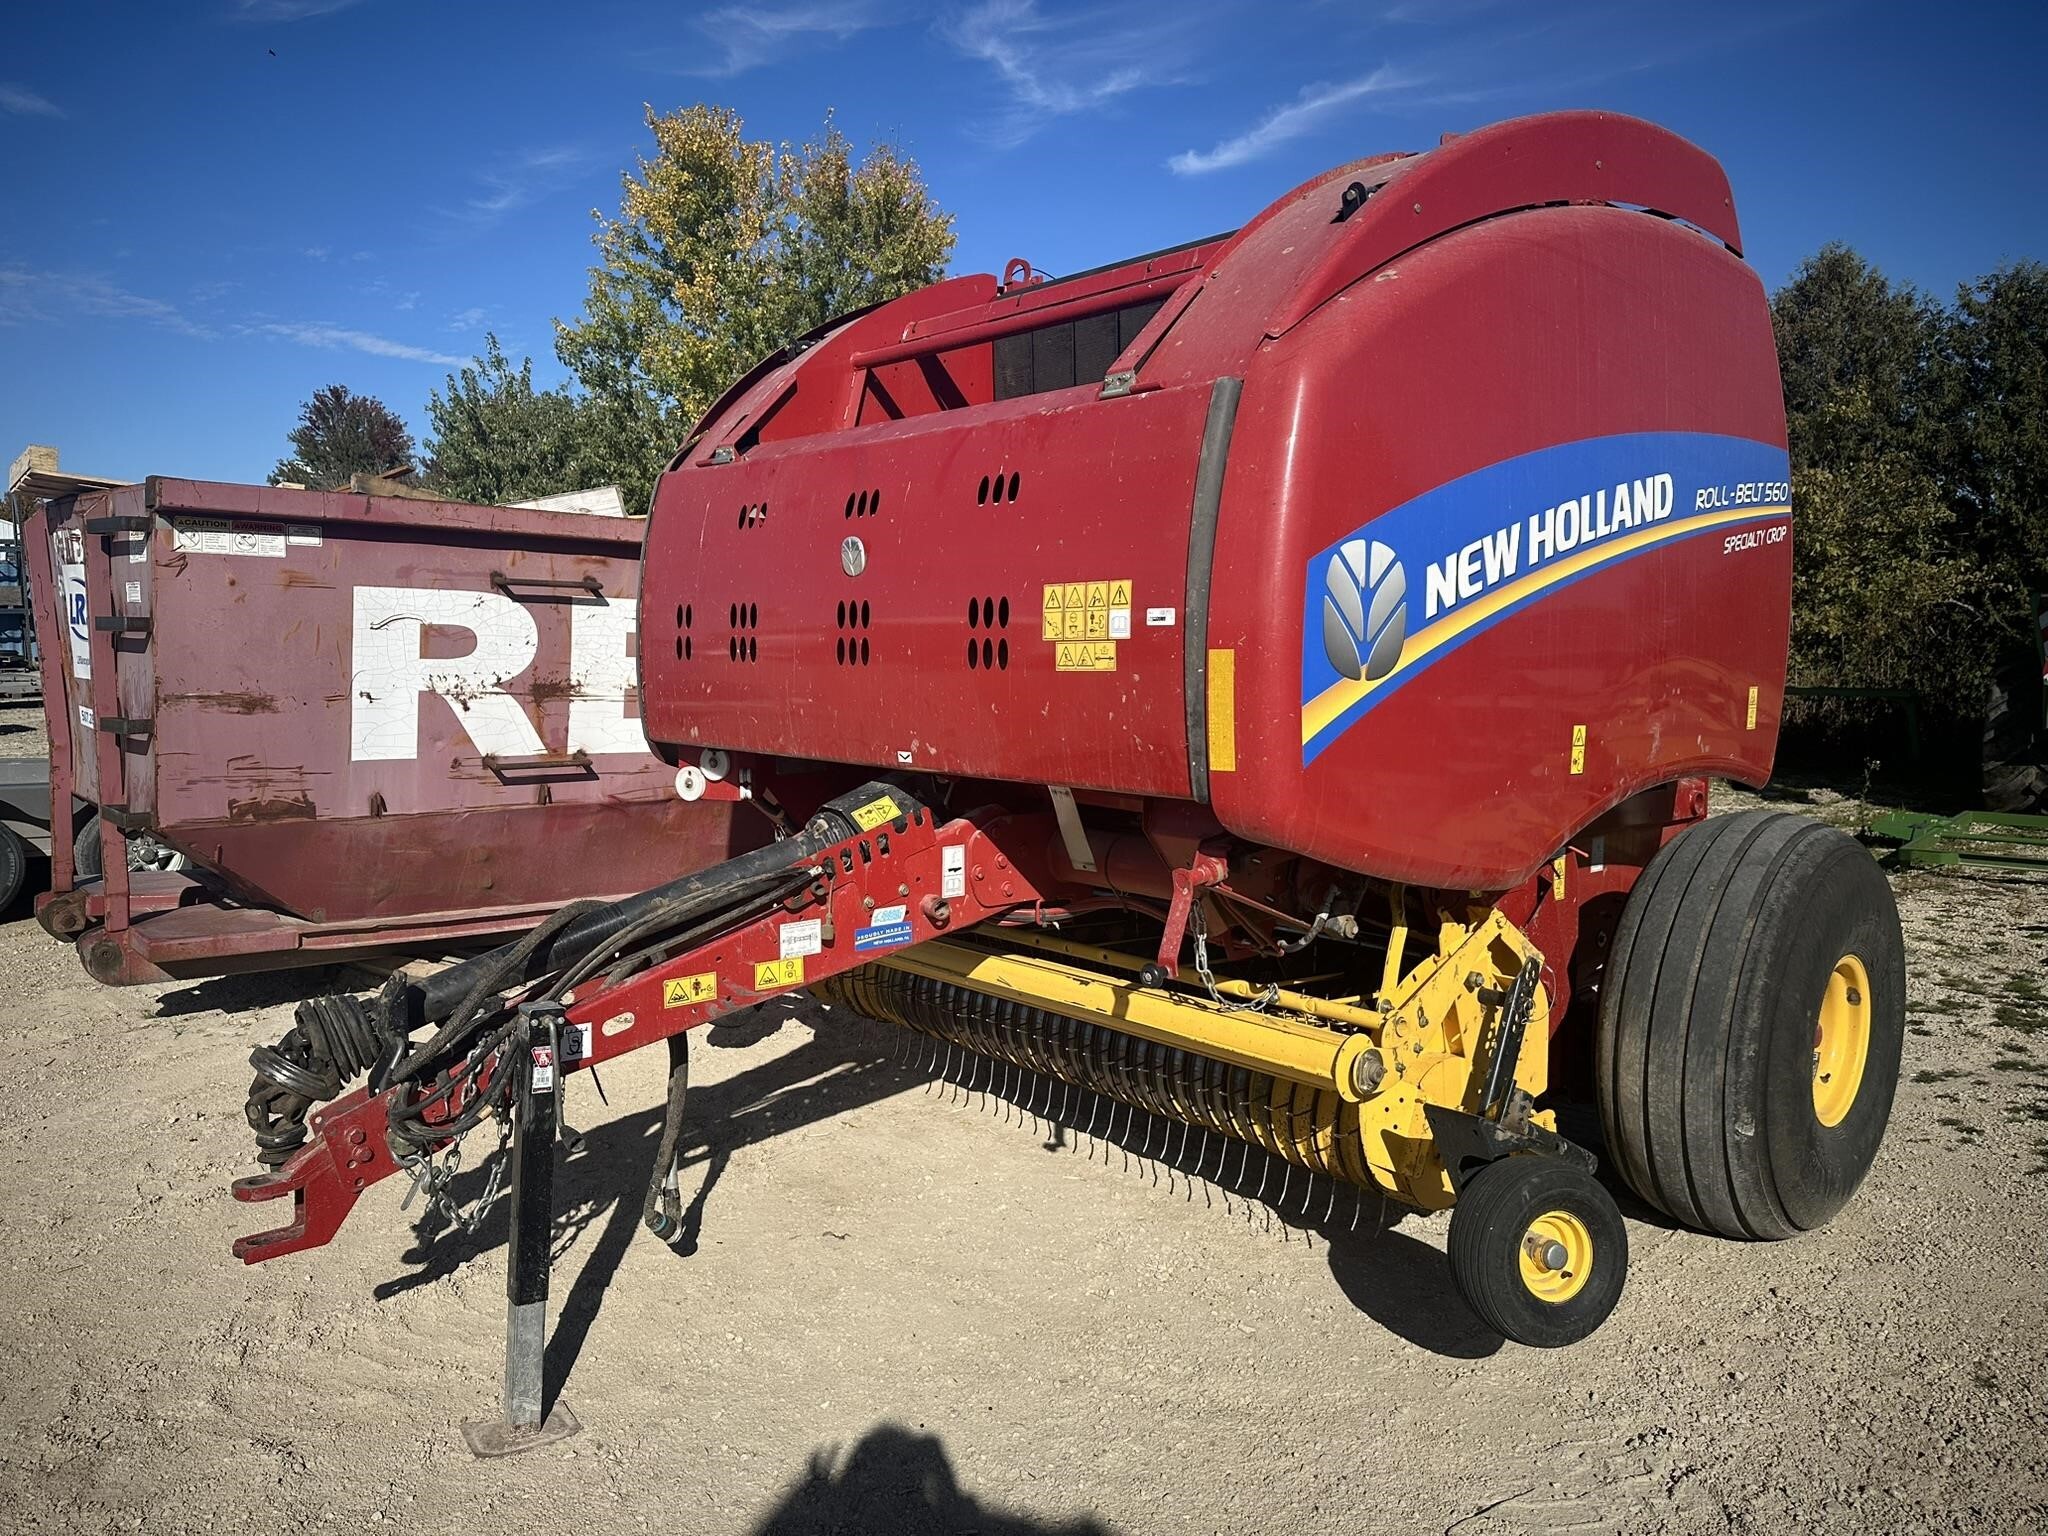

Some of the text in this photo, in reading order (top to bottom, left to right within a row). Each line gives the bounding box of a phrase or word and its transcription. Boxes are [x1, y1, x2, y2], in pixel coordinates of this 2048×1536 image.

[1764, 482, 1788, 502] 560
[184, 518, 227, 528] CAUTION
[239, 523, 282, 532] WARNING
[1425, 472, 1674, 620] NEW HOLLAND
[1723, 525, 1787, 555] SPECIALTY CROP
[856, 930, 884, 941] PROUDLY
[885, 926, 902, 934] MADE
